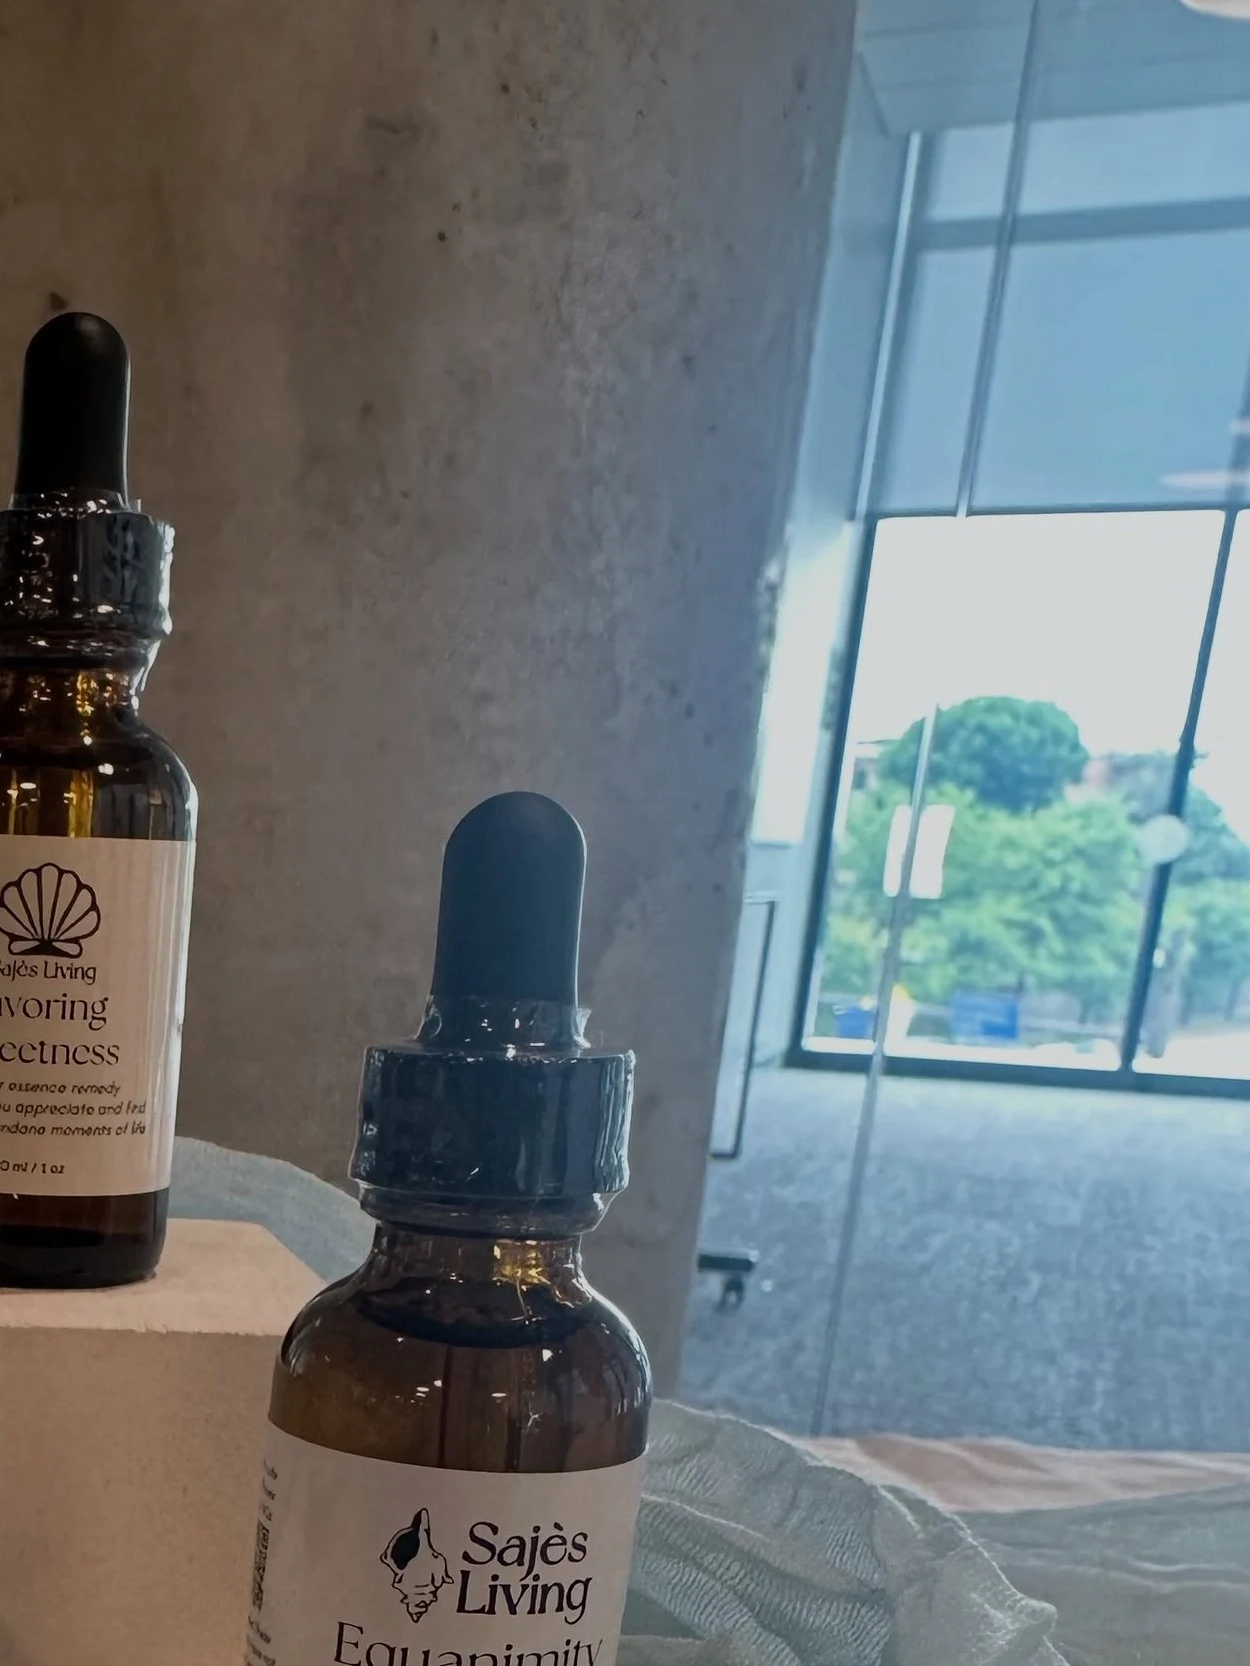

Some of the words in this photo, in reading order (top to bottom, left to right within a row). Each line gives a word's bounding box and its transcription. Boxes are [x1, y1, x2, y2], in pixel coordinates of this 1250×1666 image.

[43, 960, 97, 985] Living
[8, 1081, 66, 1094] essence
[71, 1081, 121, 1097] remedy
[16, 1102, 94, 1118] appreciate
[99, 1102, 123, 1115] and
[50, 1125, 112, 1136] moments
[50, 1164, 65, 1175] oz
[462, 1521, 588, 1580] Sajès
[455, 1570, 593, 1625] Living
